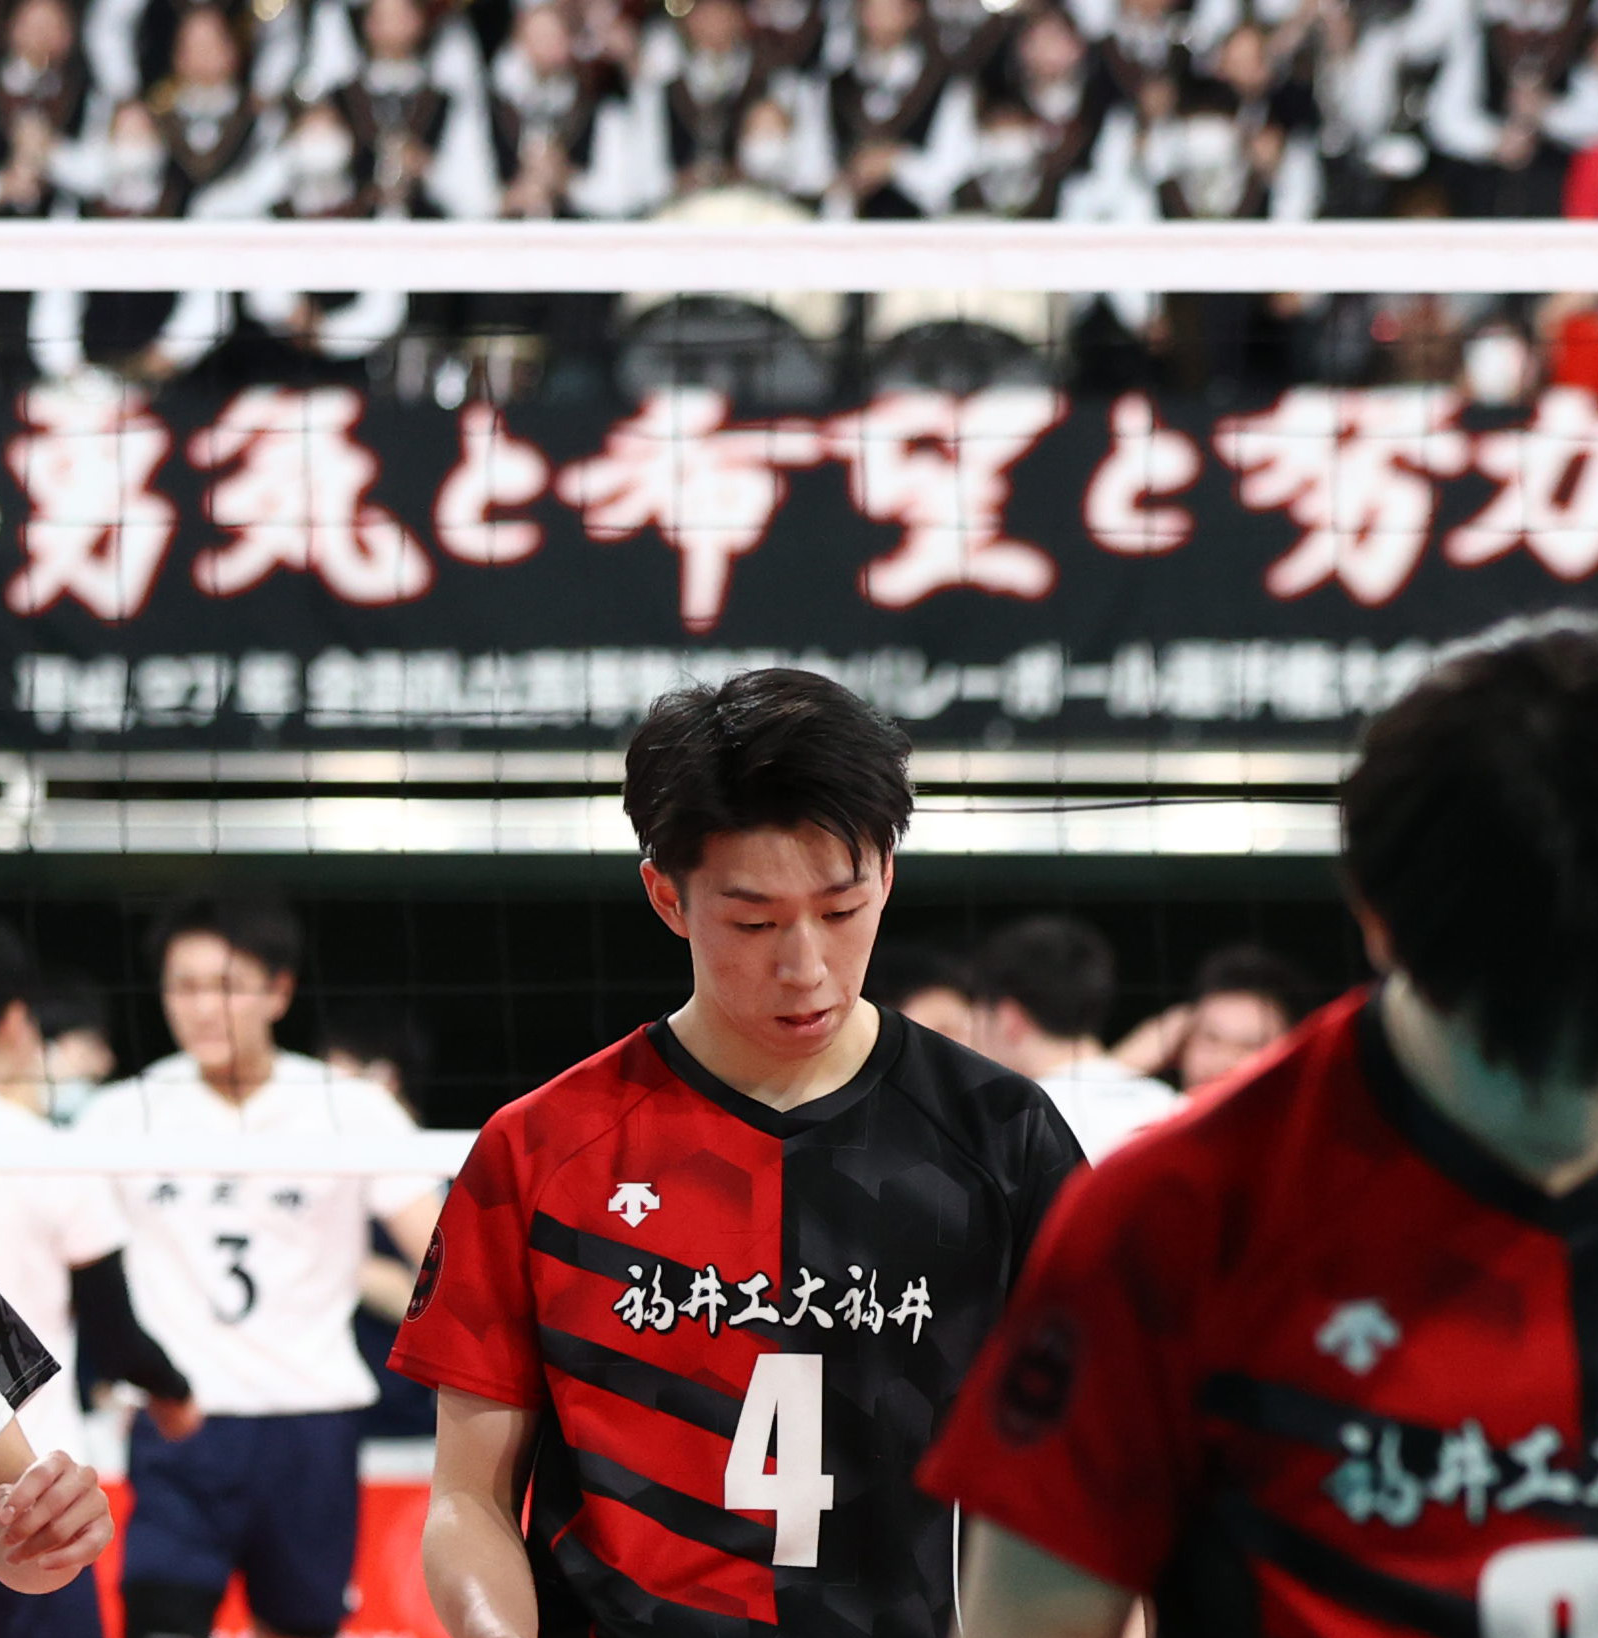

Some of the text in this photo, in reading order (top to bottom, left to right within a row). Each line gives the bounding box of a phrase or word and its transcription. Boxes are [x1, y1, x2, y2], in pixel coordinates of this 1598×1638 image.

[214, 1232, 258, 1326] 3
[613, 1264, 933, 1344] 福井工大福井
[724, 1353, 834, 1568] 4
